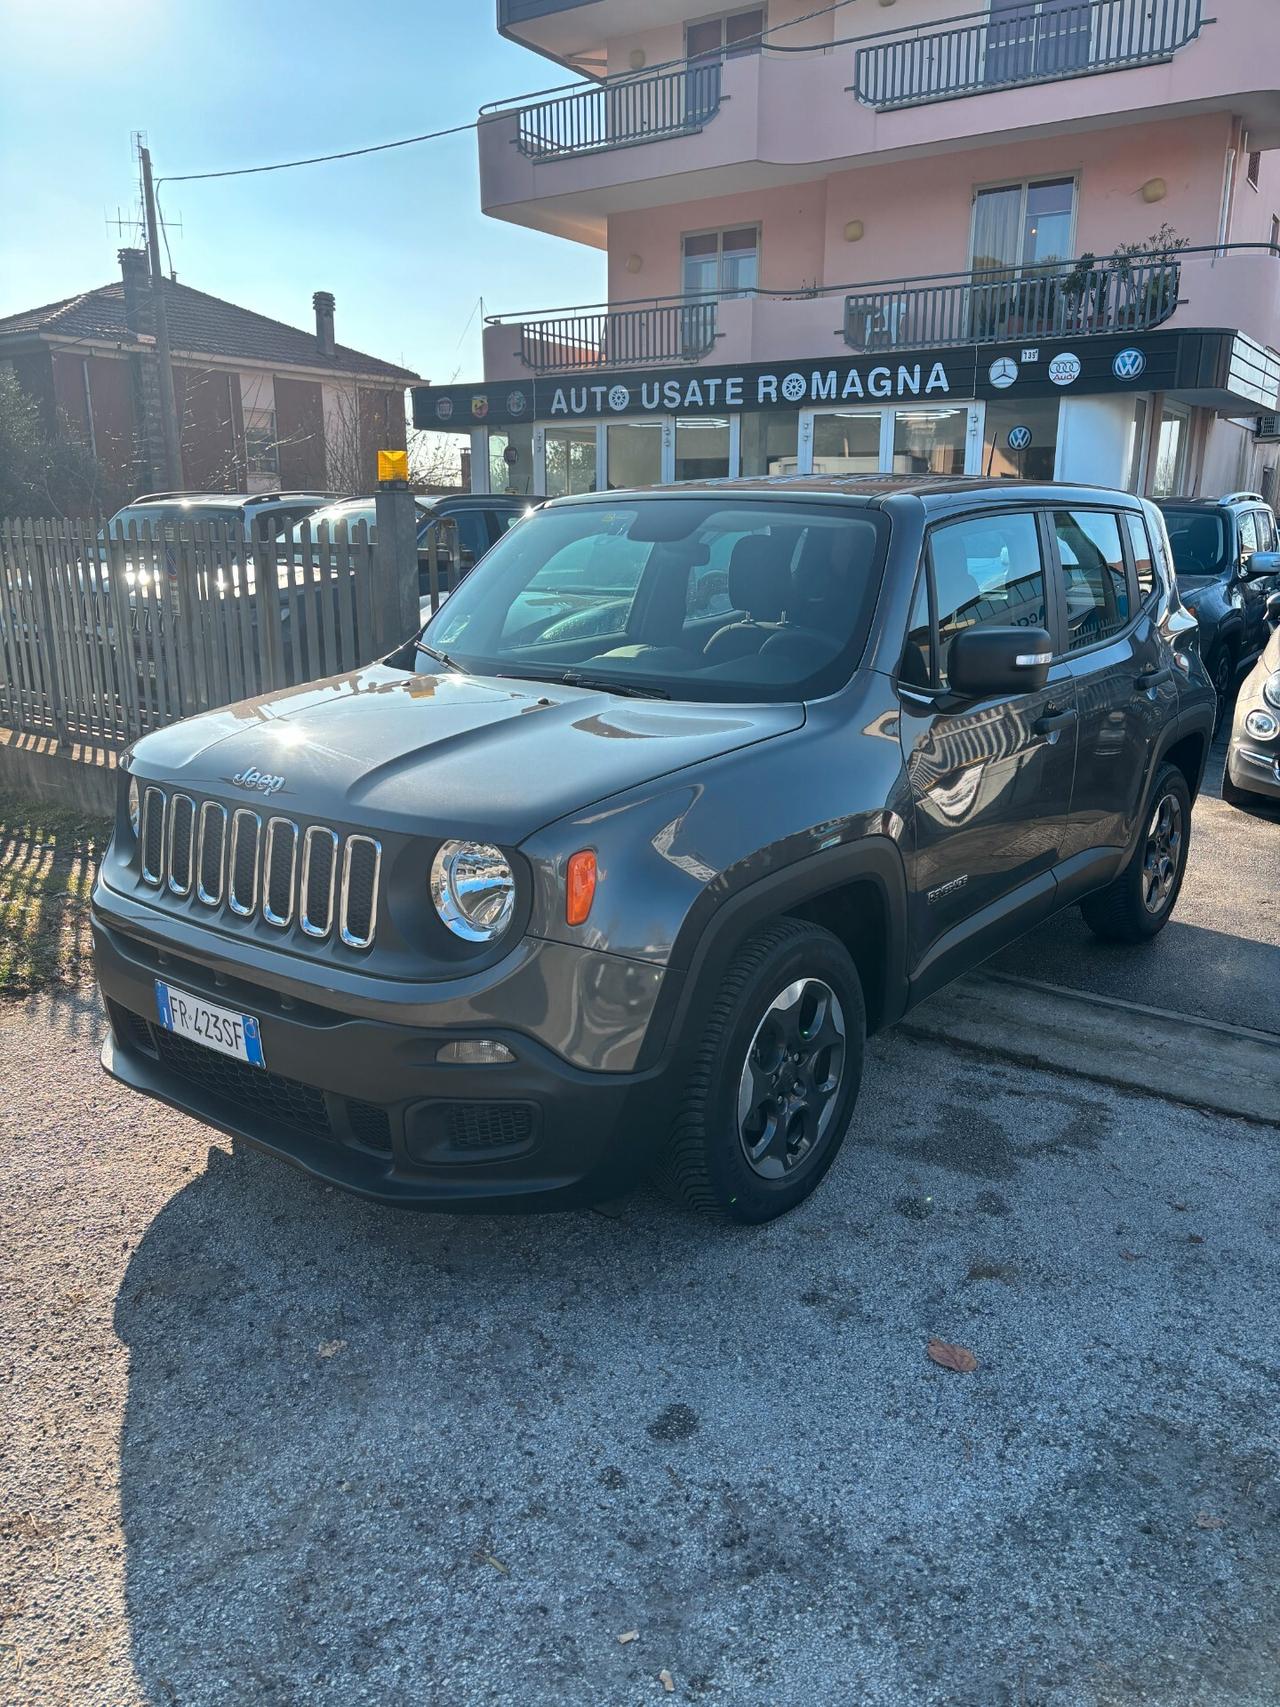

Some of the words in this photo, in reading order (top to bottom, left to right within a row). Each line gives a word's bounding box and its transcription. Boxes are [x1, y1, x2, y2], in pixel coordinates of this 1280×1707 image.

[550, 384, 630, 415] AUTO
[641, 377, 744, 410] USATE
[757, 362, 950, 403] ROMAGNA
[233, 766, 285, 796] Jeep
